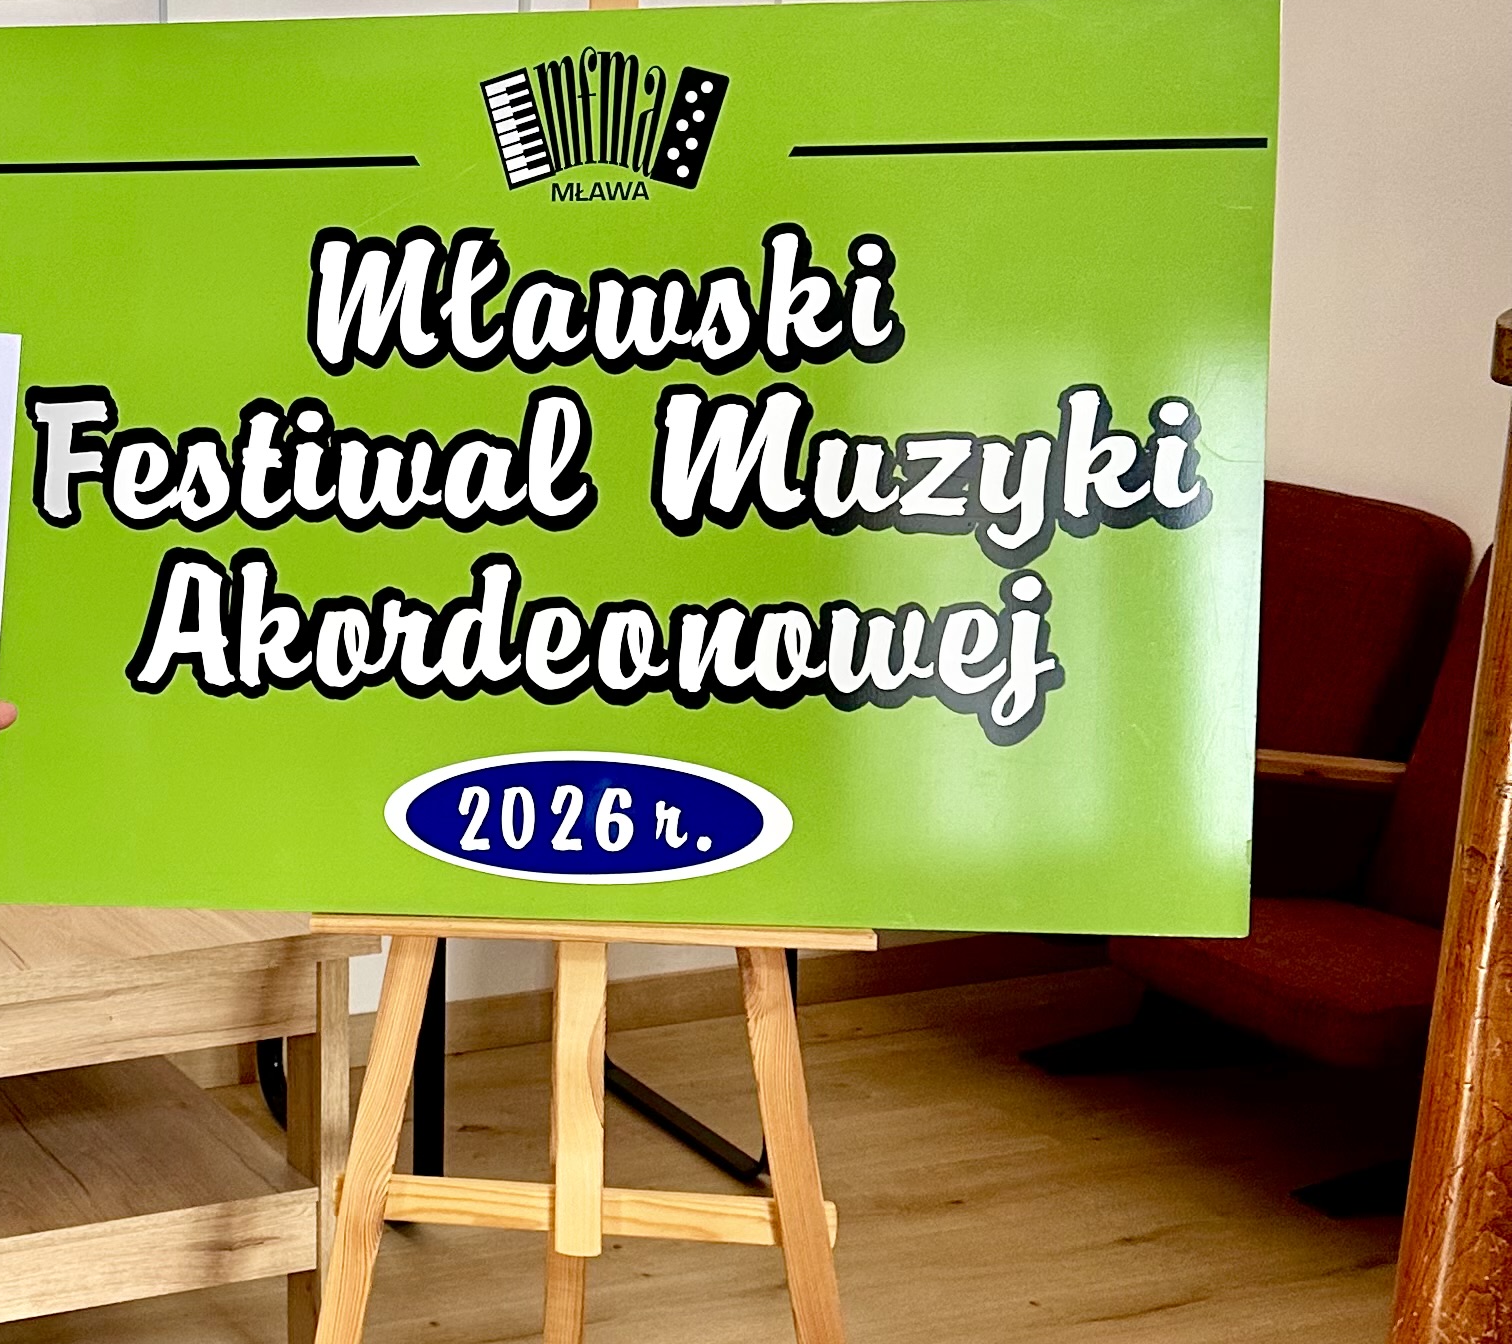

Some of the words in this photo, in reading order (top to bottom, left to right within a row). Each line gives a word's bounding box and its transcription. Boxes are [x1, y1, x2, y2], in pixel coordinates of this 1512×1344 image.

[551, 181, 650, 202] MŁAWA
[307, 223, 905, 376] Mławski
[25, 385, 598, 533] Festiwal
[651, 383, 1213, 567] Muzyki
[125, 547, 1065, 744] Akordeonowej
[458, 784, 634, 852] 2026
[655, 800, 712, 852] r.
